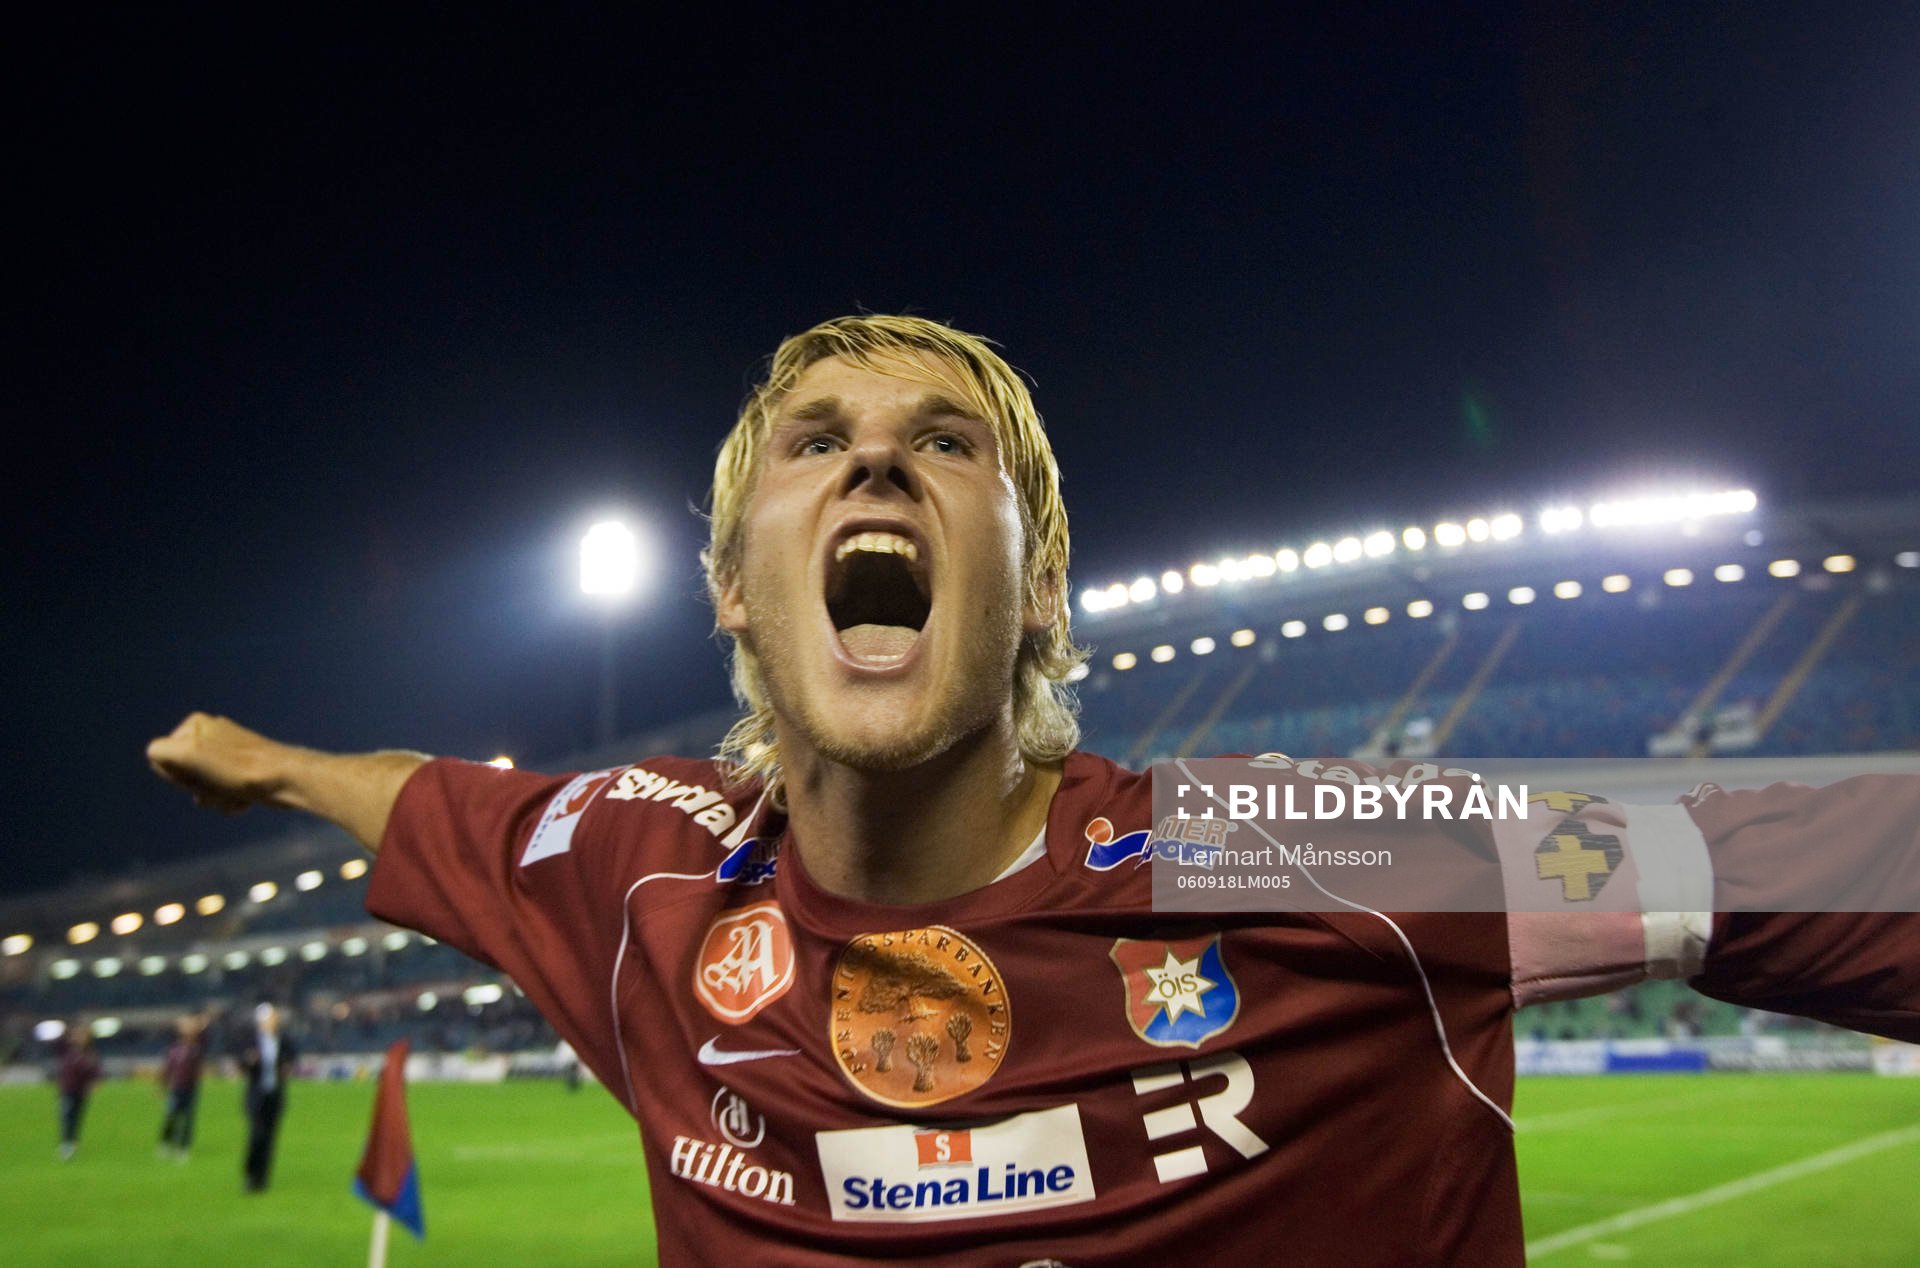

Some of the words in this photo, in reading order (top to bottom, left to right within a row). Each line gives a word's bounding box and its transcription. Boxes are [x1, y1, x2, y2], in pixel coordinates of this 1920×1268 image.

[1158, 973, 1199, 999] ÖIS
[935, 1134, 951, 1162] S
[670, 1135, 797, 1206] Hilton
[843, 1176, 969, 1210] Stena
[977, 1163, 1076, 1203] Line
